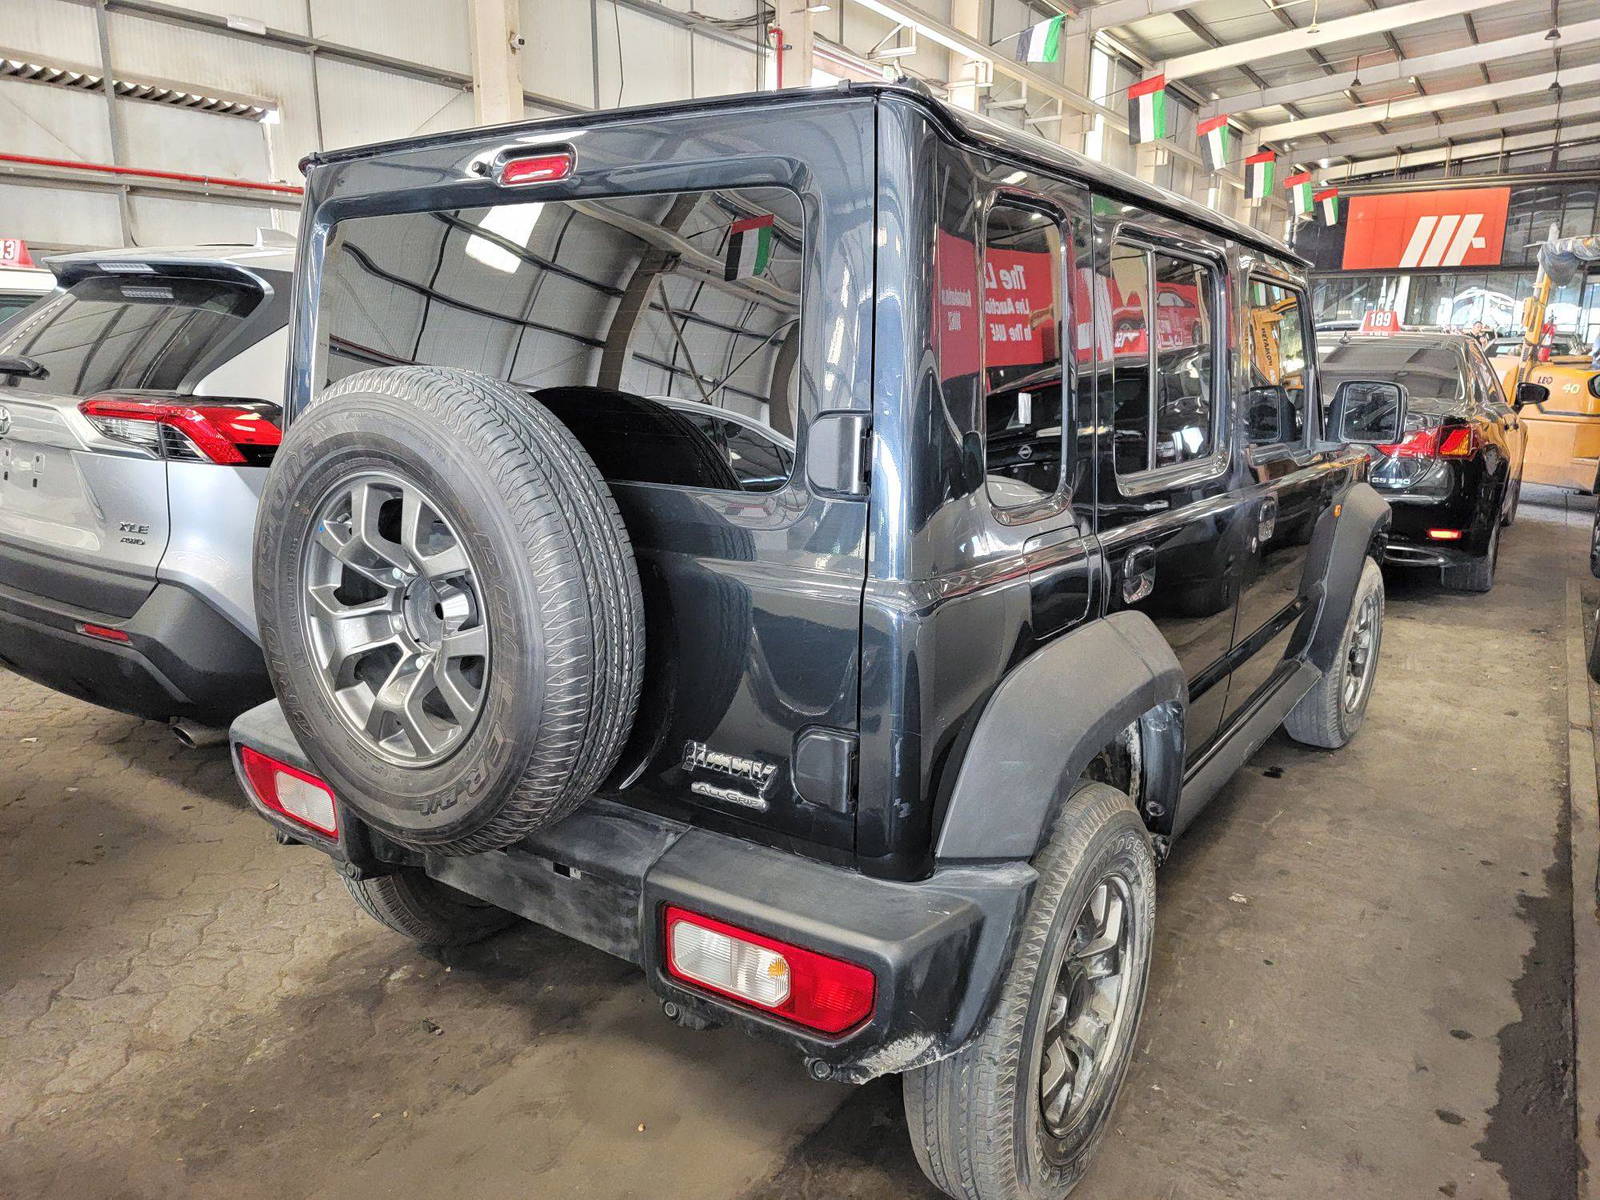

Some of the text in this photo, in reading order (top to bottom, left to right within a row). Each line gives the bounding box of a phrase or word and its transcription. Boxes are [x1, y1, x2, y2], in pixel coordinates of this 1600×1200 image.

[1370, 312, 1391, 327] 189
[1537, 376, 1553, 385] LEO
[1562, 383, 1580, 394] 40
[120, 522, 149, 535] XLE
